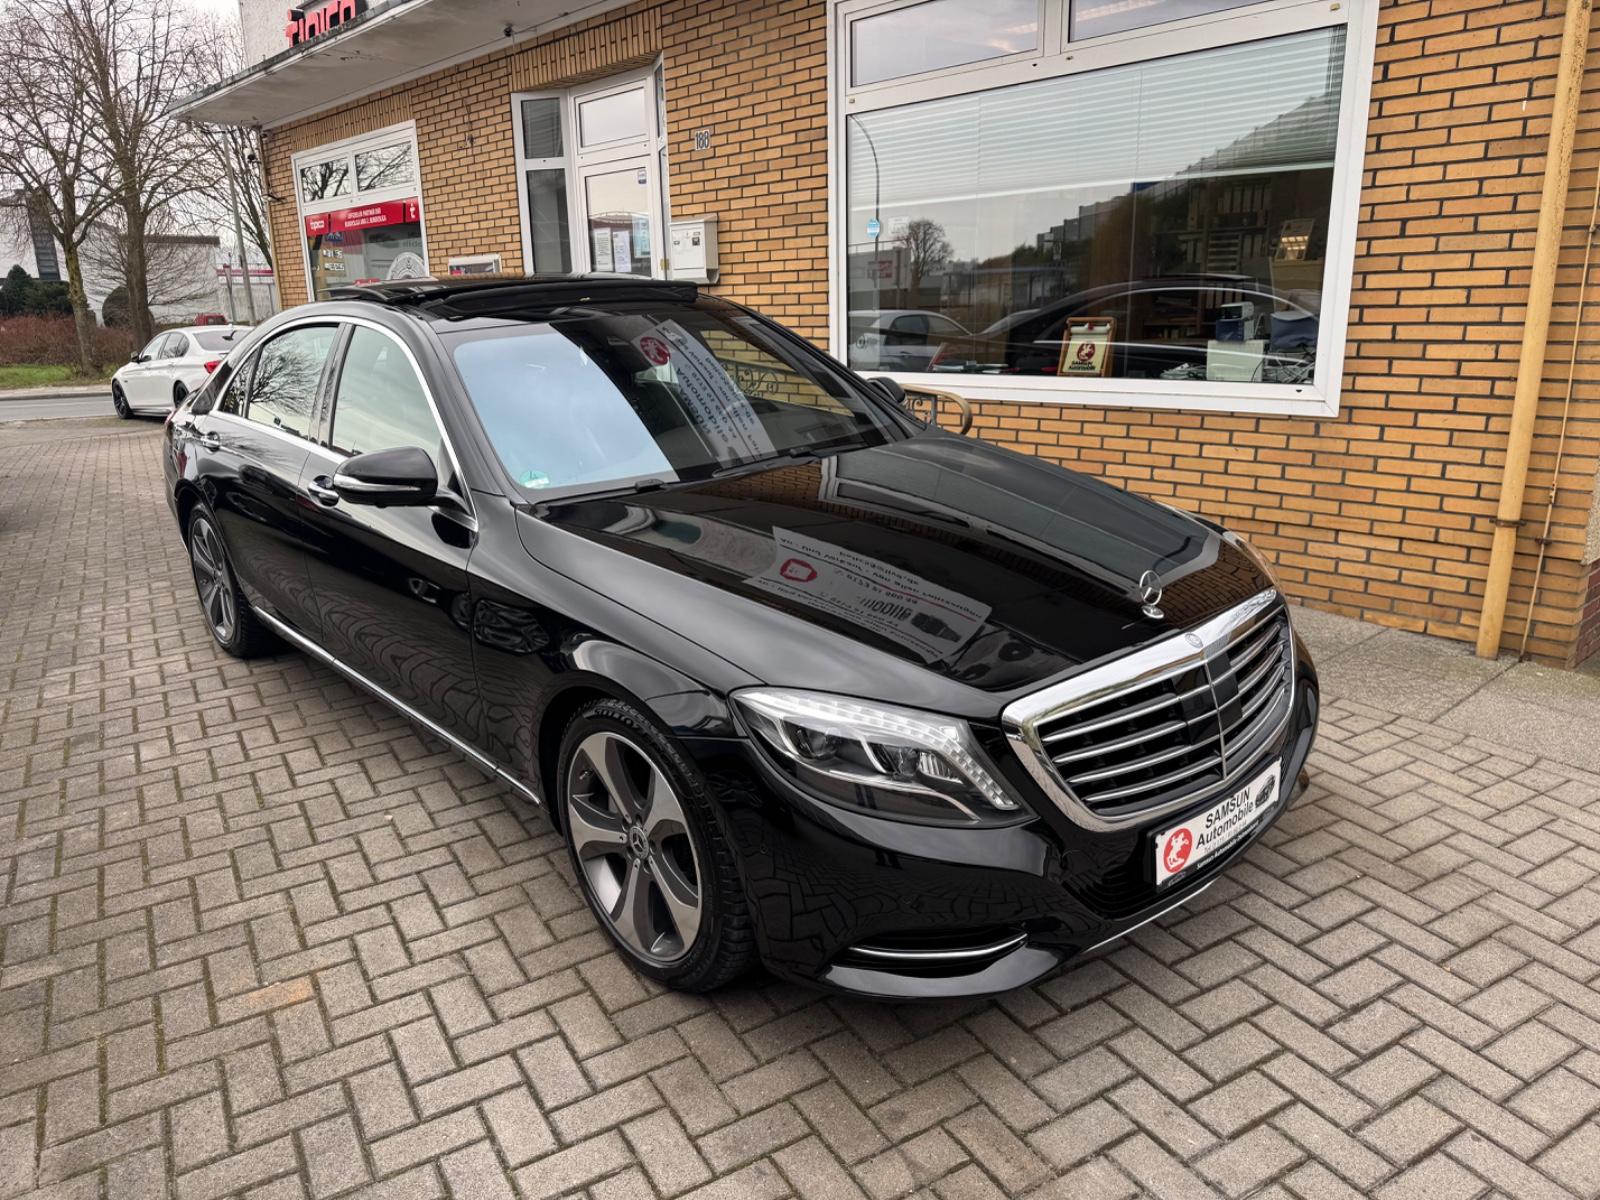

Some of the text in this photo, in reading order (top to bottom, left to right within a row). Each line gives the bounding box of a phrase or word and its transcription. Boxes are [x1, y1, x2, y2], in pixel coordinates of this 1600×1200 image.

[695, 130, 710, 149] 188
[1196, 800, 1254, 850] Automobile
[1205, 786, 1250, 829] SAMSUN
